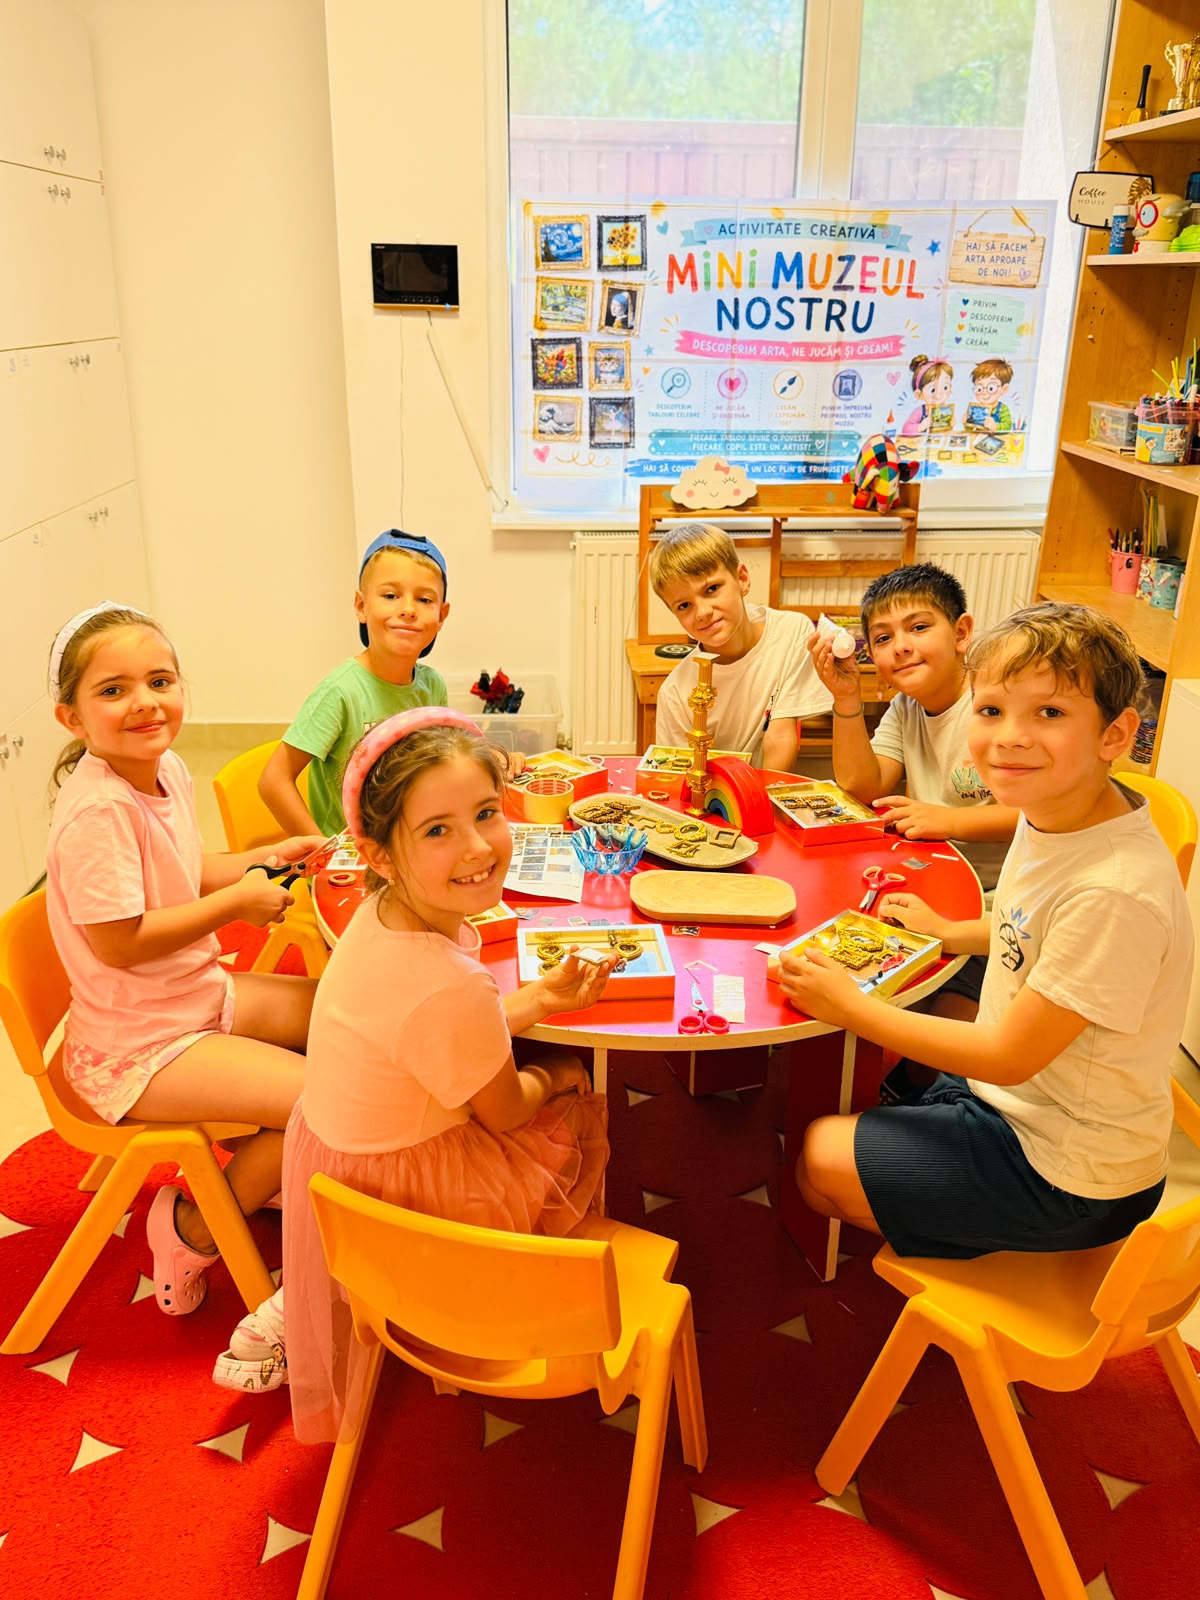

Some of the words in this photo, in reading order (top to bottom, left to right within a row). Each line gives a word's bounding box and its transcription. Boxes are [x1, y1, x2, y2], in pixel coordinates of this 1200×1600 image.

[1079, 187, 1107, 198] Coffee
[718, 222, 802, 236] ACTIVITATE
[810, 223, 876, 240] CREATIVĂ
[966, 242, 981, 250] HAI
[985, 240, 996, 251] SĂ
[1000, 243, 1028, 252] FACEM
[965, 255, 986, 264] ARTA
[989, 255, 1027, 265] APROAPE
[771, 251, 925, 300] MUZEUL
[977, 268, 988, 277] DE
[992, 268, 1012, 277] NOI!
[972, 299, 998, 309] PRIVIM
[716, 296, 875, 334] NOSTRU
[970, 312, 1013, 324] DESCOPERIM
[692, 339, 757, 356] DESCOPERIM
[760, 345, 789, 358] ARTA,
[792, 347, 806, 358] NE
[808, 344, 842, 358] JUCĂM
[844, 345, 854, 359] ȘI
[692, 442, 722, 451] FIECARE
[726, 443, 747, 451] COPIL
[750, 443, 767, 451] ESTE
[770, 443, 780, 451] UN
[782, 443, 812, 451] ARTIST!
[643, 464, 657, 473] HAI
[659, 463, 670, 473] SĂ
[751, 465, 762, 473] UN
[764, 465, 776, 474] LOC
[797, 465, 807, 474] DE
